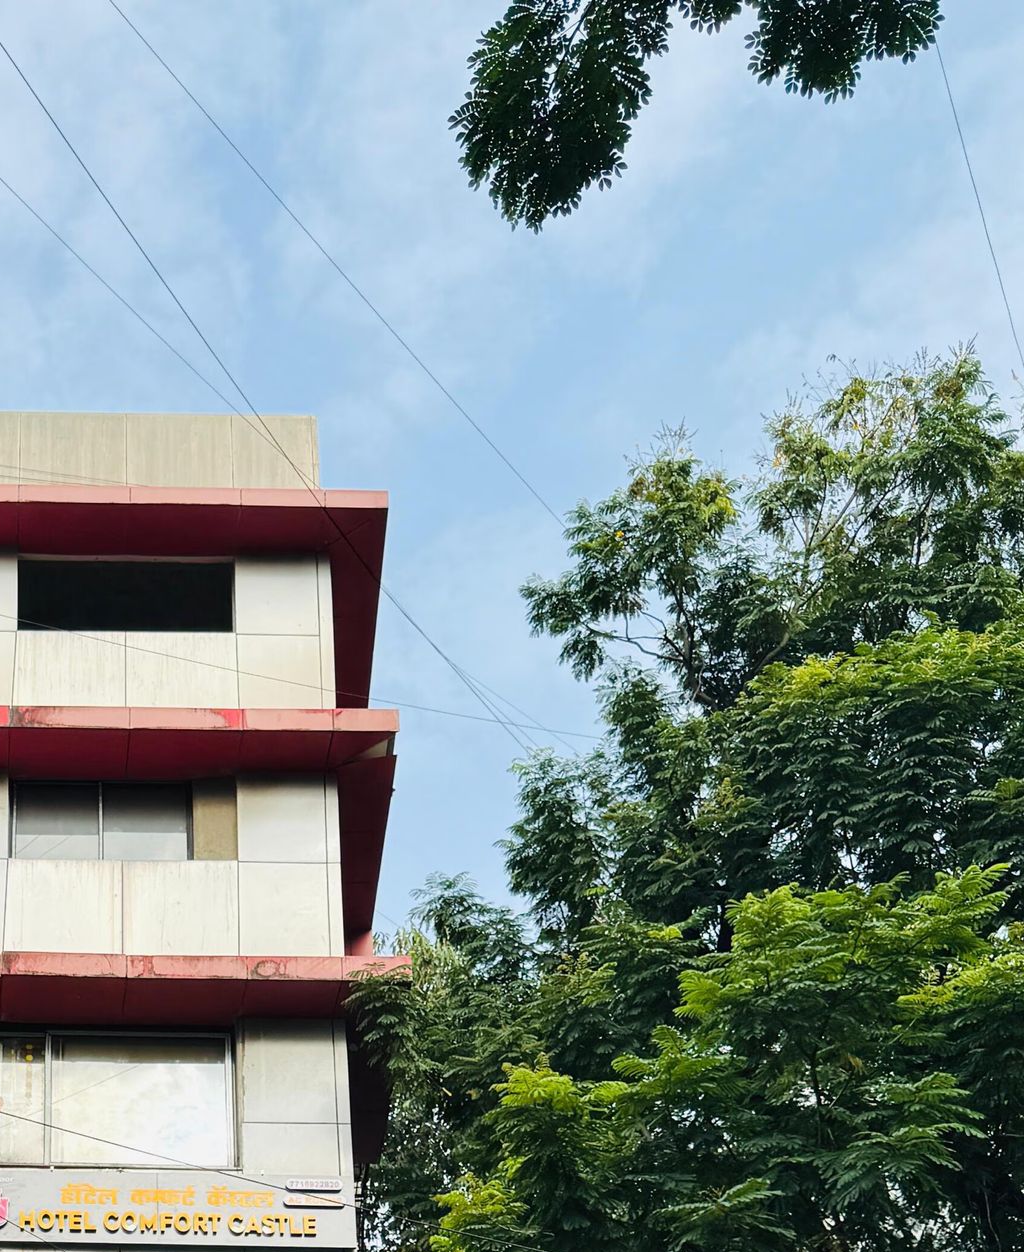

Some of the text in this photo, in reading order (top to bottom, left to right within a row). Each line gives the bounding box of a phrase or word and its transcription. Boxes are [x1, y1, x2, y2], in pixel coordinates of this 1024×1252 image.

[18, 1208, 317, 1238] HOTEL COMFORT CASTLE
